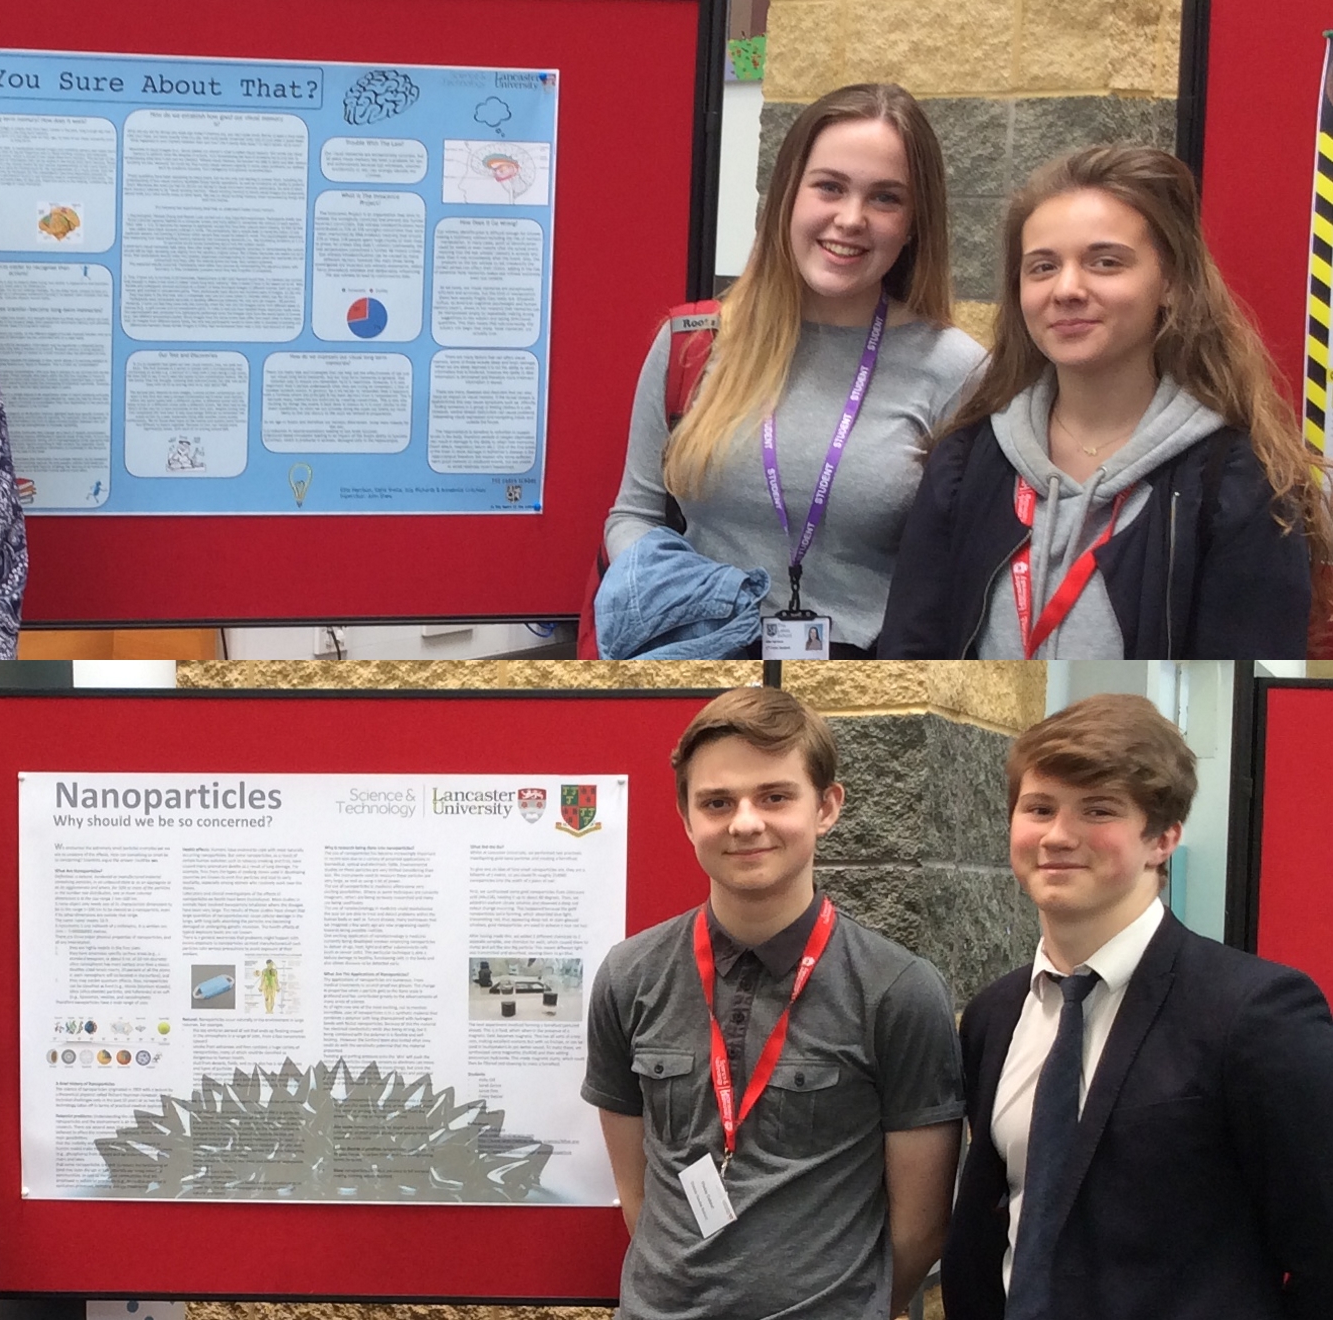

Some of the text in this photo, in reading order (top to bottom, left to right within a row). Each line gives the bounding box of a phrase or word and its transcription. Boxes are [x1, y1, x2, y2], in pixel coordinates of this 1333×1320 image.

[59, 71, 124, 92] Sure
[141, 75, 222, 96] About
[239, 78, 319, 99] That?
[494, 79, 538, 91] University
[867, 316, 883, 351] STUDENT
[850, 365, 869, 401] STUDENT
[833, 413, 852, 448] STUDENT
[767, 467, 783, 510] STUDENT
[814, 462, 834, 505] STUDENT
[796, 521, 816, 562] TUDENT
[56, 781, 283, 815] Nanoparticles
[335, 801, 417, 818] Technology
[349, 788, 416, 802] Science &
[432, 787, 516, 802] Lancaster
[432, 801, 513, 819] University
[53, 815, 273, 829] Why should we be so concerned?
